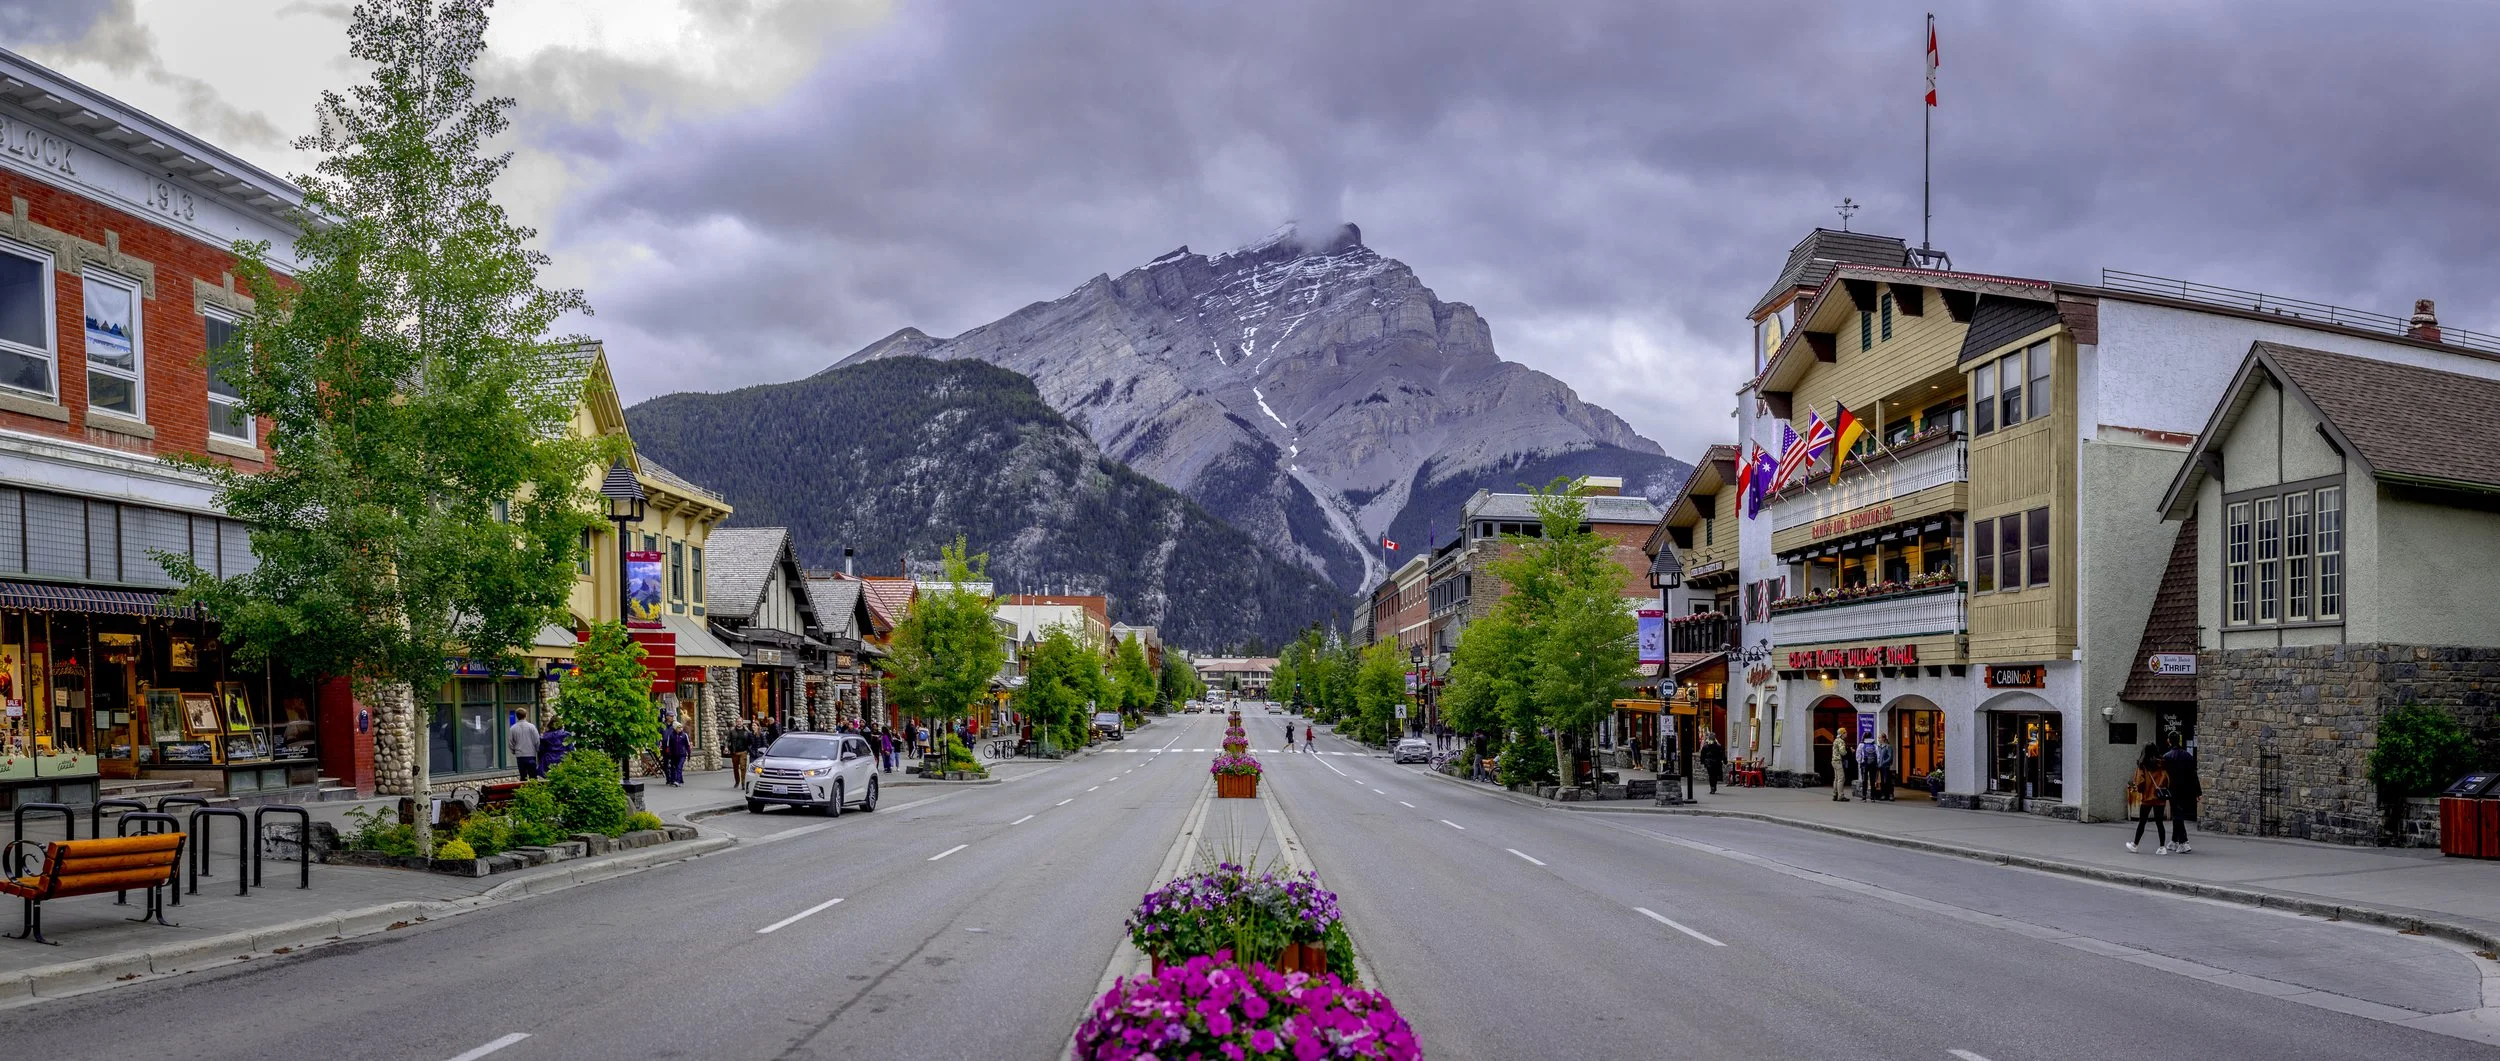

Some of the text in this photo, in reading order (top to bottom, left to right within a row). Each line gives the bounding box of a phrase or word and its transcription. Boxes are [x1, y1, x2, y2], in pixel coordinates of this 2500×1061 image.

[145, 175, 196, 221] 1913
[1788, 643, 1916, 669] CLOCK TOWER VILLAGE MALL
[2163, 663, 2191, 672] THRIFT
